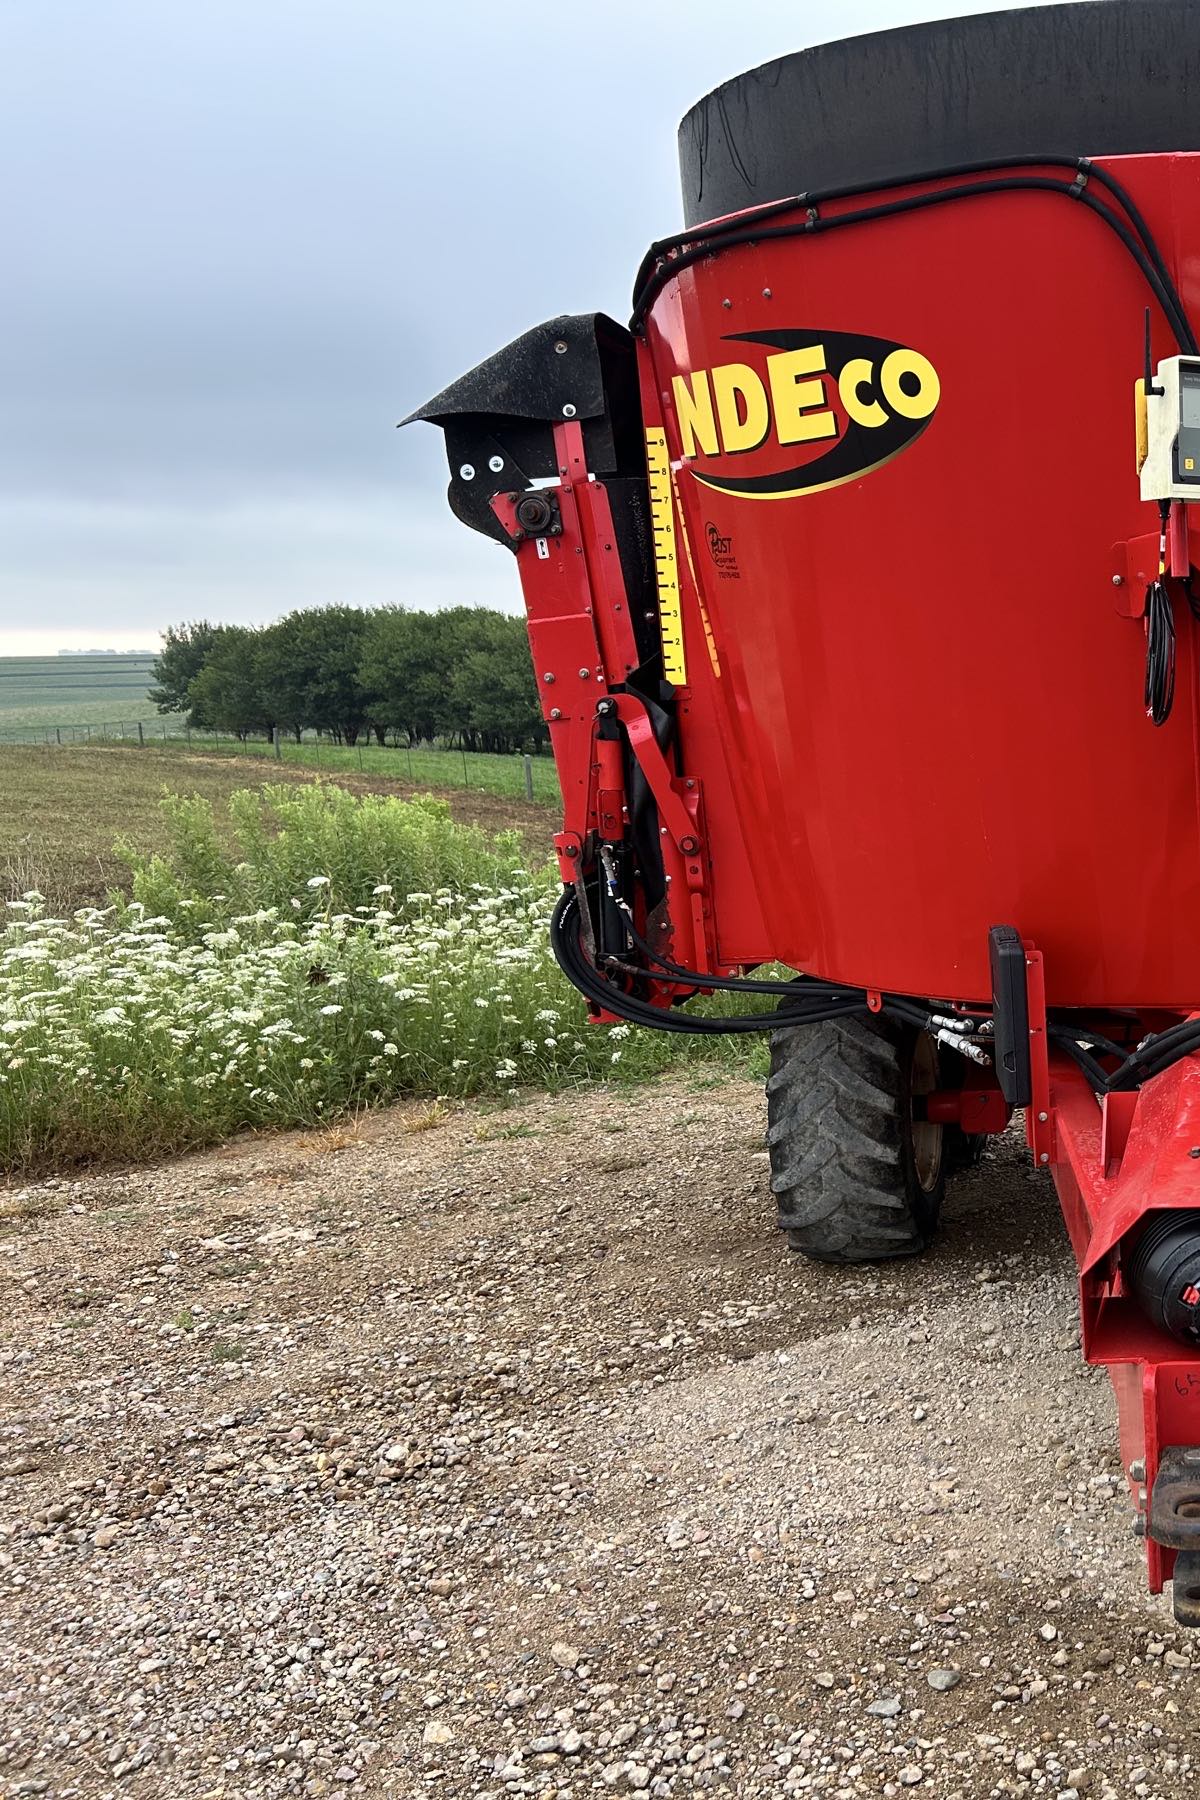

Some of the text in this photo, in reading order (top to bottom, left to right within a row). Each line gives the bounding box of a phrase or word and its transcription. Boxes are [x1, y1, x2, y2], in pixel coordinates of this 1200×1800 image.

[659, 438, 665, 447] 9
[661, 467, 667, 476] 8
[663, 496, 669, 504] 7
[666, 525, 671, 533] 6
[668, 553, 674, 561] 5
